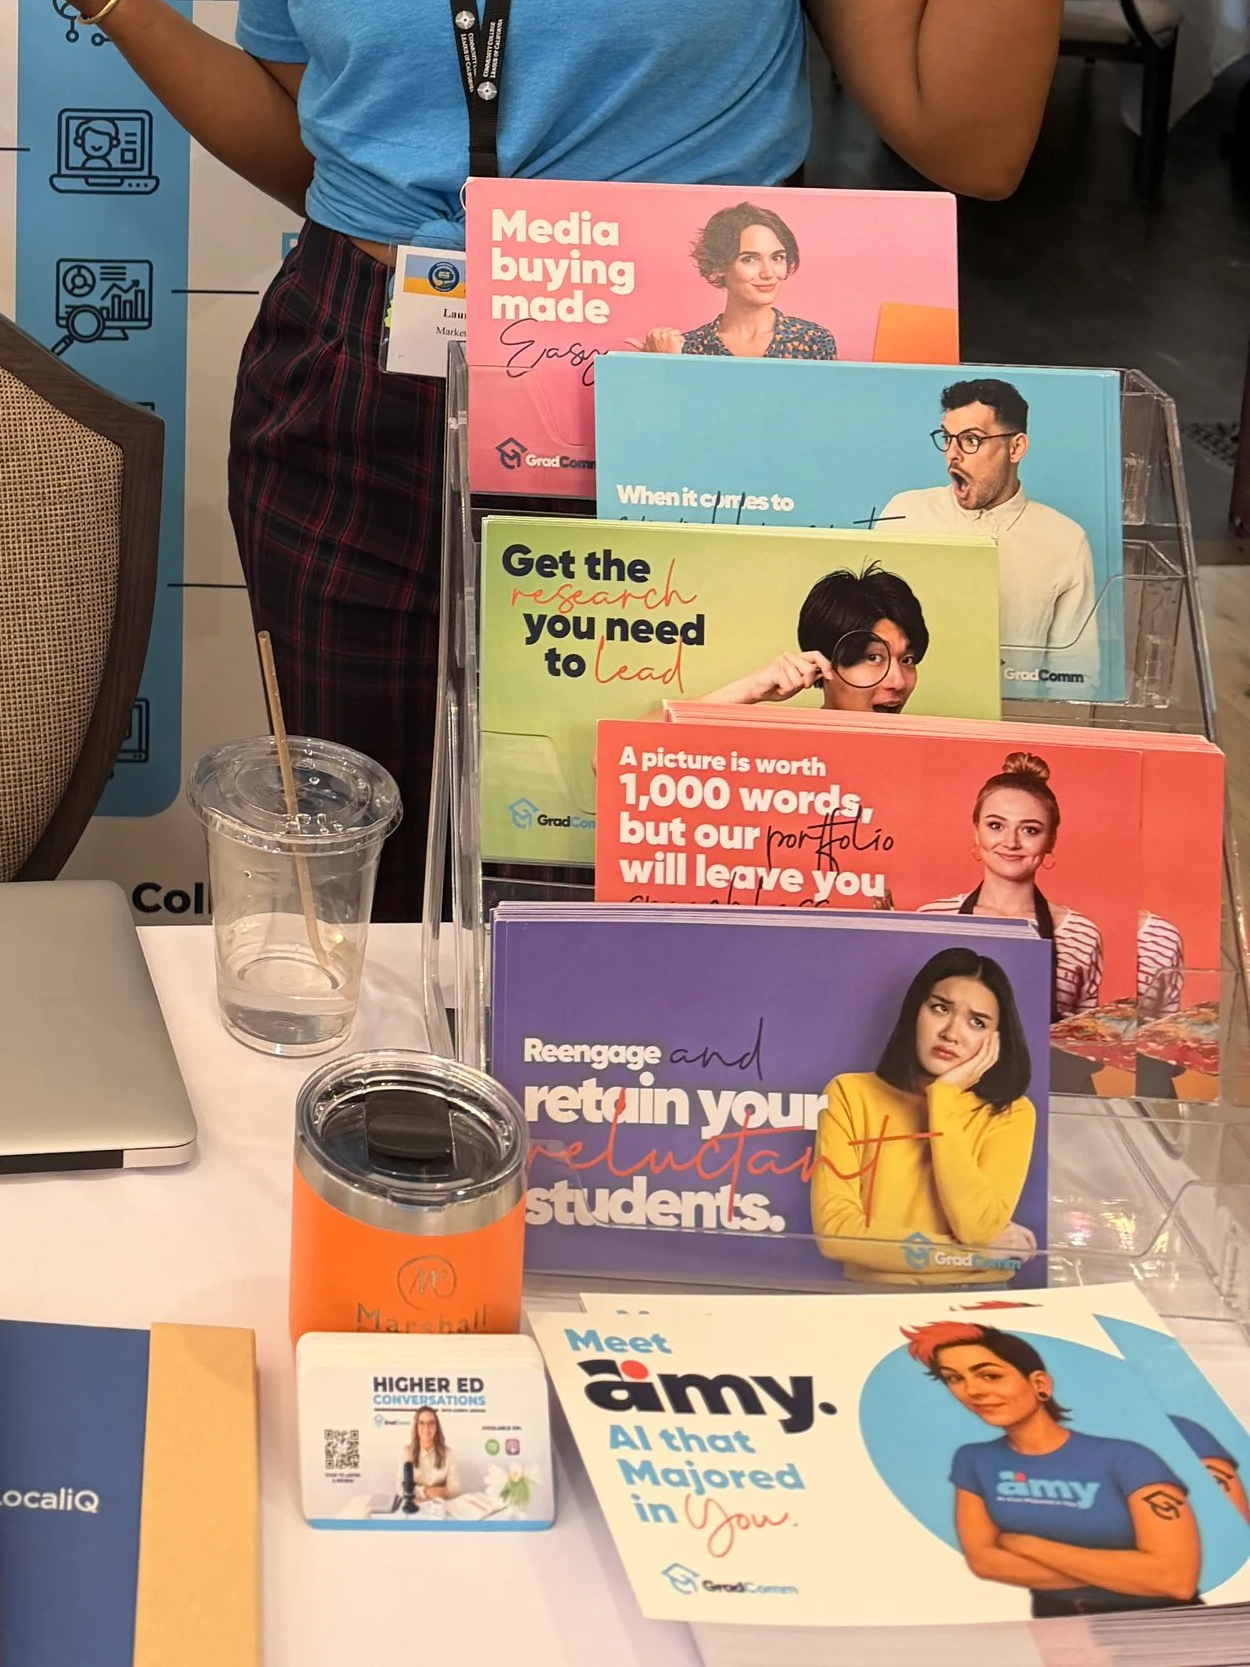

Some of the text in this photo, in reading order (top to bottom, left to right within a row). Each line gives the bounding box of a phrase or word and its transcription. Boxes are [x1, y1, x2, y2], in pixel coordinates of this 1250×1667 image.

[491, 208, 619, 248] Media
[491, 248, 636, 296] buying
[491, 289, 611, 325] made
[616, 483, 795, 512] When it comes to
[501, 542, 651, 584] Get the
[509, 556, 698, 613] research
[522, 610, 706, 647] you need
[544, 626, 684, 694] to lead
[1004, 667, 1085, 684] GradComm
[619, 746, 827, 777] A picture is worth
[618, 772, 875, 824] 1,000 words,
[619, 804, 895, 872] but our portfolio
[618, 850, 687, 887] will
[695, 854, 804, 894] leave
[811, 869, 886, 902] you
[523, 1017, 765, 1080] Reengage and
[523, 1074, 830, 1142] retain your
[525, 1086, 945, 1228] reluctant
[523, 1174, 787, 1234] students.
[563, 1327, 672, 1356] Meet
[373, 1376, 485, 1394] HIGHER ED
[373, 1394, 487, 1407] CONVERSATIONS
[576, 1358, 838, 1434] amy.
[608, 1424, 756, 1455] AI that
[617, 1457, 806, 1496] Majored
[996, 1469, 1101, 1510] amy
[633, 1493, 679, 1526] in
